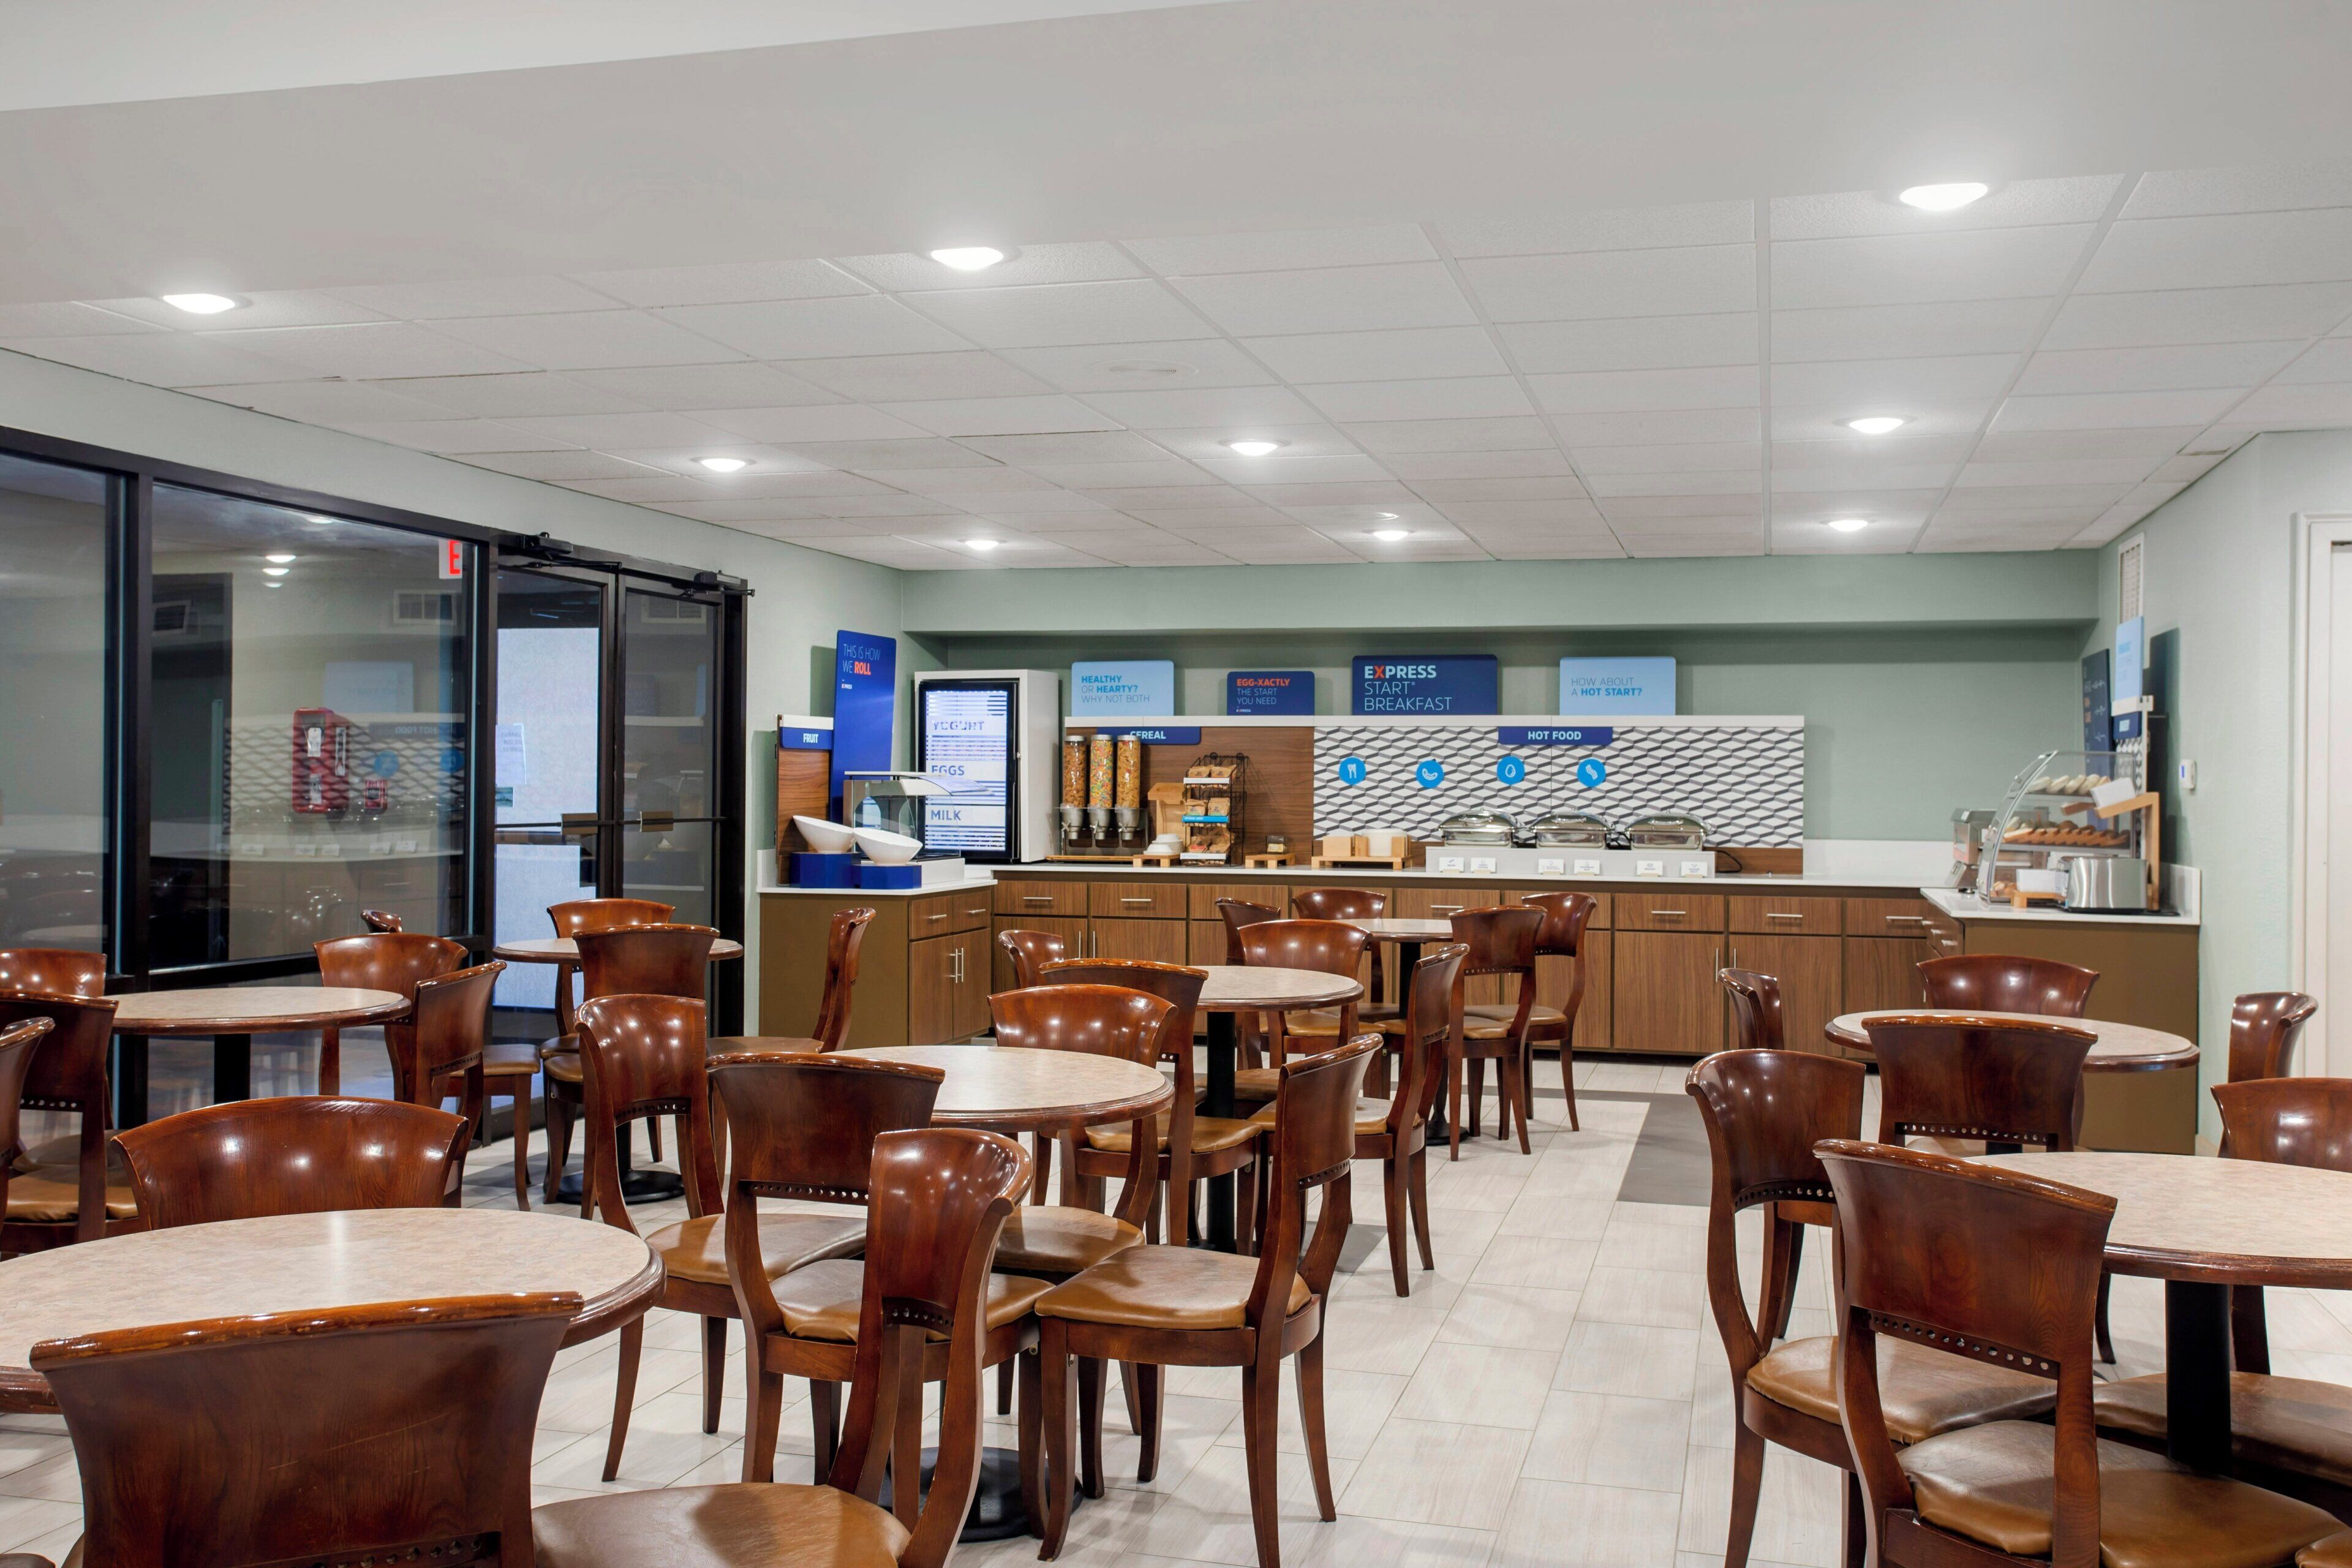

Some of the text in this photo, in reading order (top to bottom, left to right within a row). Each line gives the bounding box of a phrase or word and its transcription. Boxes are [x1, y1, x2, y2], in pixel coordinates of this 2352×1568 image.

[843, 644, 881, 660] THIS IS HOW
[843, 660, 871, 675] WE ROLL
[1365, 665, 1437, 679] EXPRESS
[1571, 677, 1634, 686] HOW ABOUT
[1082, 695, 1102, 703] WHY
[1365, 697, 1452, 711] BREAKFAST
[803, 733, 819, 744] FRUIT
[1130, 731, 1166, 739] CEREAL
[1528, 731, 1581, 740] HOT FOOD
[932, 765, 965, 776] EGGS
[930, 810, 962, 821] MILK
